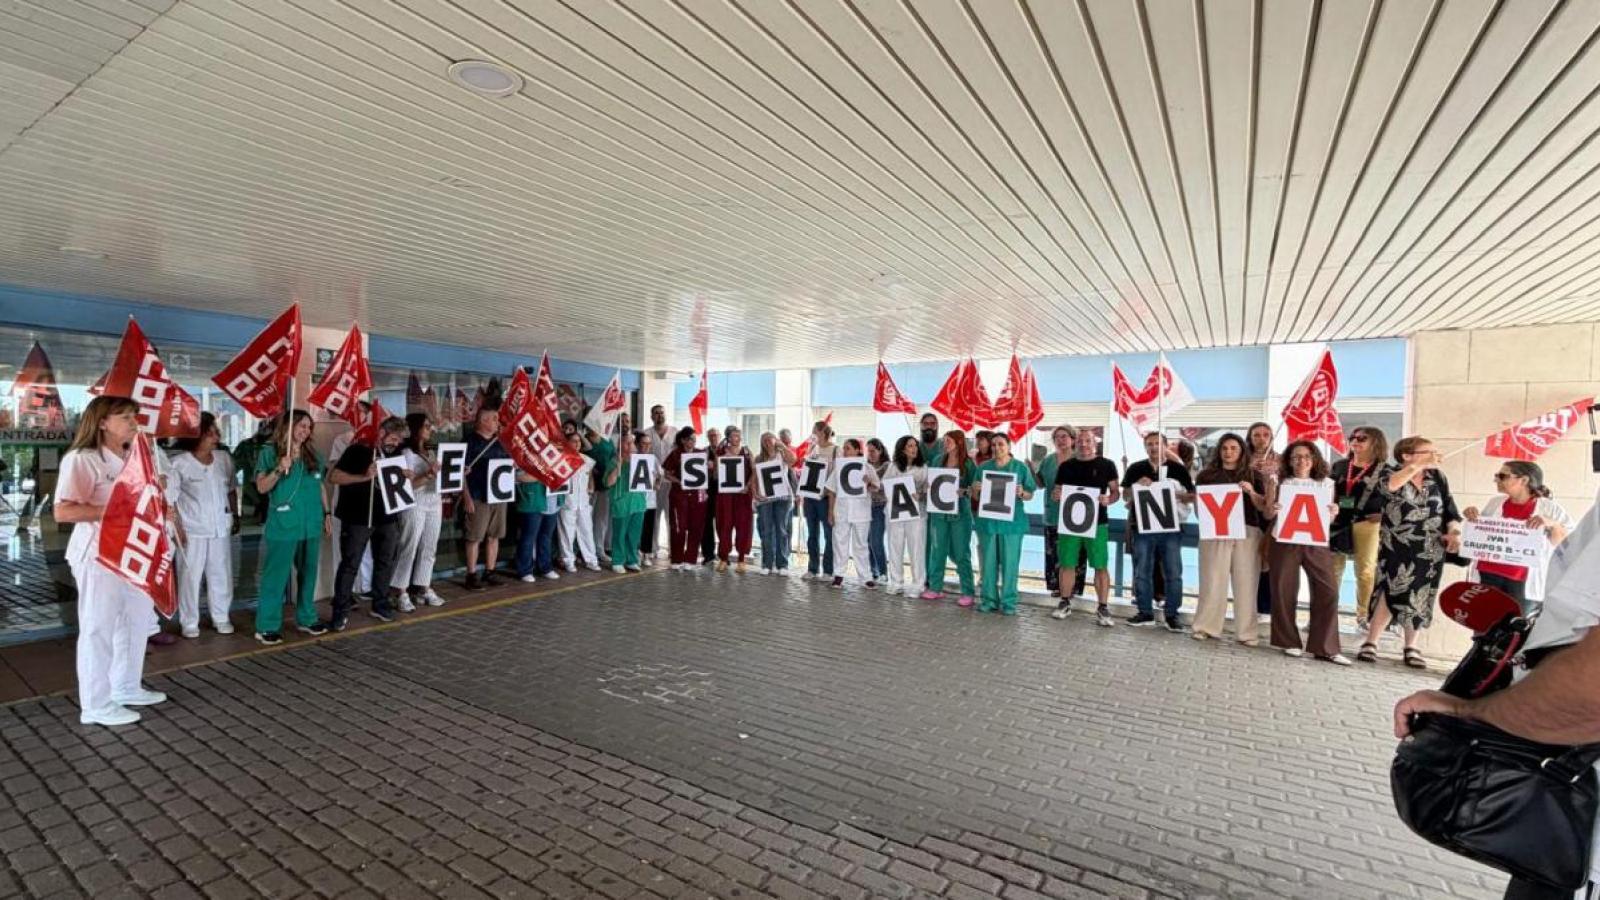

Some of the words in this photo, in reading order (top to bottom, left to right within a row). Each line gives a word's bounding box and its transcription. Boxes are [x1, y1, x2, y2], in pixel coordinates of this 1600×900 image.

[0, 430, 67, 440] NTRADA
[517, 412, 573, 478] CCOO
[1464, 540, 1503, 551] GRUPOS
